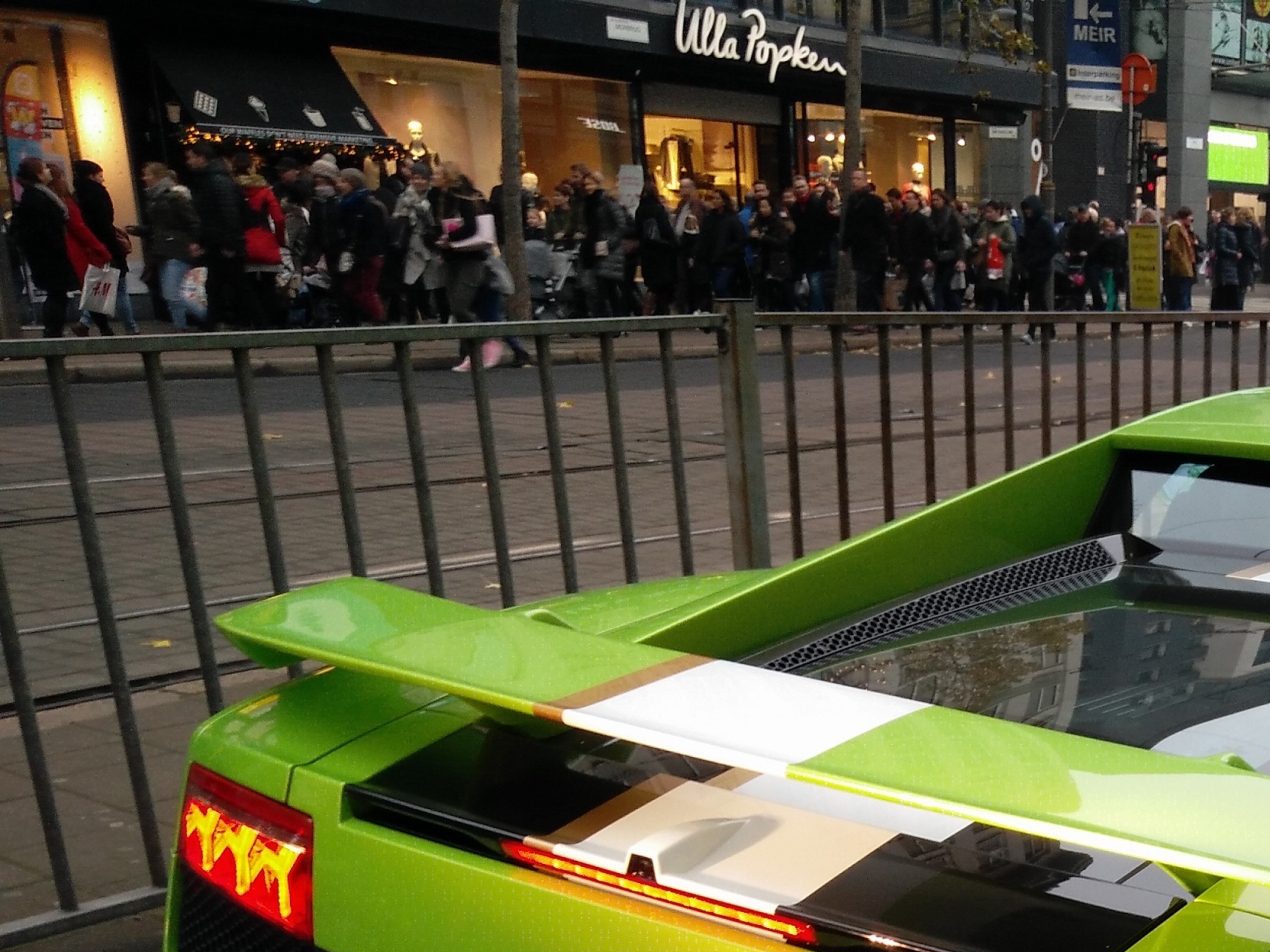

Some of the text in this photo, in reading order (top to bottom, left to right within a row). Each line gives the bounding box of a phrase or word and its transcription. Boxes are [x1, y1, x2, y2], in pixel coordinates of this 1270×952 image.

[675, 0, 847, 84] Ulla Popken
[1073, 24, 1117, 43] MEIR
